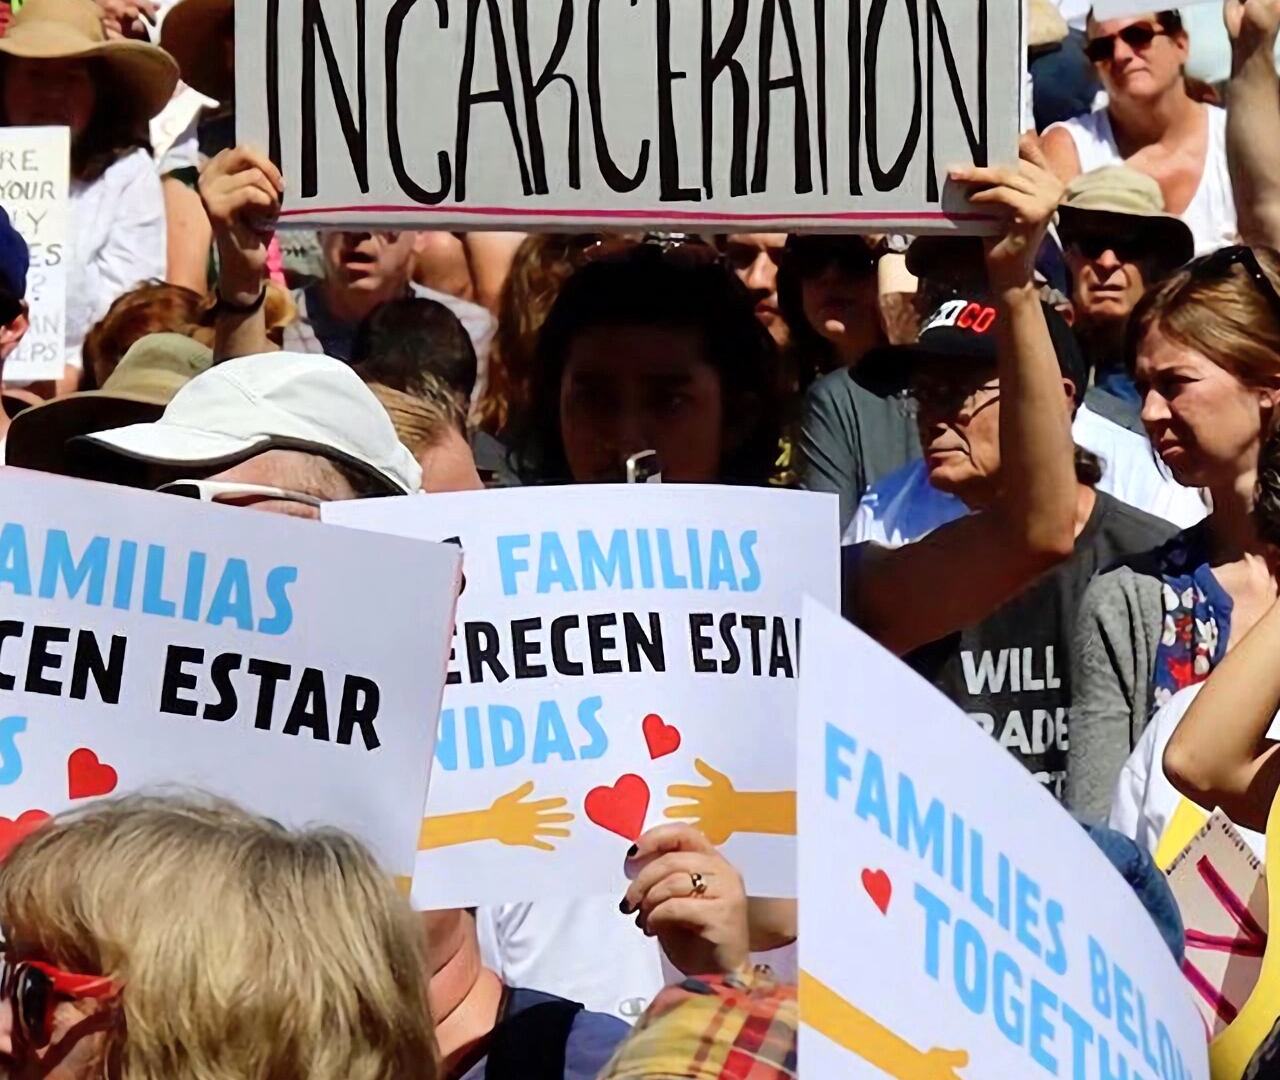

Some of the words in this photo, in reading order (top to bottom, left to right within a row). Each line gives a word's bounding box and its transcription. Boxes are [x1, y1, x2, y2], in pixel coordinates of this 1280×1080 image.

[496, 527, 762, 597] FAMILIAS
[689, 611, 801, 681] ESTA
[959, 644, 1062, 696] WILL
[159, 644, 382, 753] ESTAR
[824, 720, 1068, 977] FAMILIES
